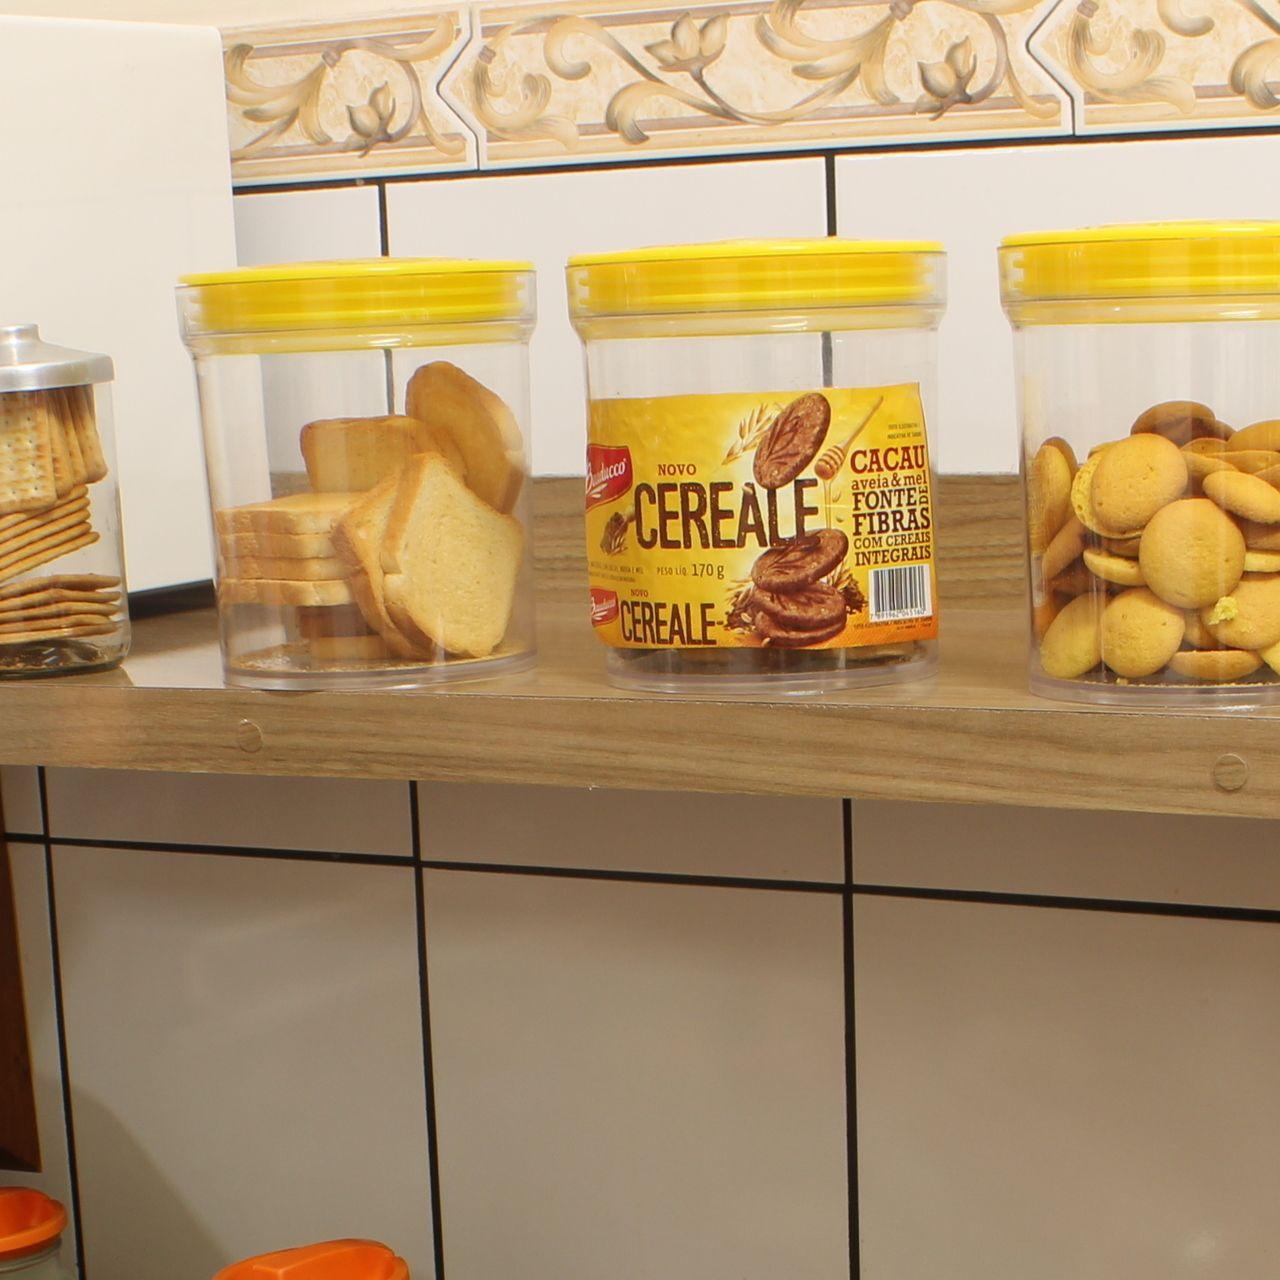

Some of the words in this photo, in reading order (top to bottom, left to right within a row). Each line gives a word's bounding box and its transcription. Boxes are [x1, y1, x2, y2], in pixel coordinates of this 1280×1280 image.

[658, 464, 696, 476] NOVO
[850, 445, 926, 474] CACAU
[851, 474, 890, 491] aveia
[891, 472, 901, 487] &
[904, 470, 927, 486] mel
[853, 487, 917, 511] FONTE
[919, 485, 929, 504] DE
[634, 478, 819, 549] CEREALE
[853, 507, 930, 536] FIBRAS
[854, 537, 882, 549] COM
[886, 532, 931, 547] CEREAIS
[854, 545, 931, 566] INTEGRAIS
[656, 566, 673, 576] PESO
[691, 563, 714, 577] 170
[717, 565, 725, 580] g
[631, 589, 648, 598] NOVO
[621, 600, 717, 645] CEREALE
